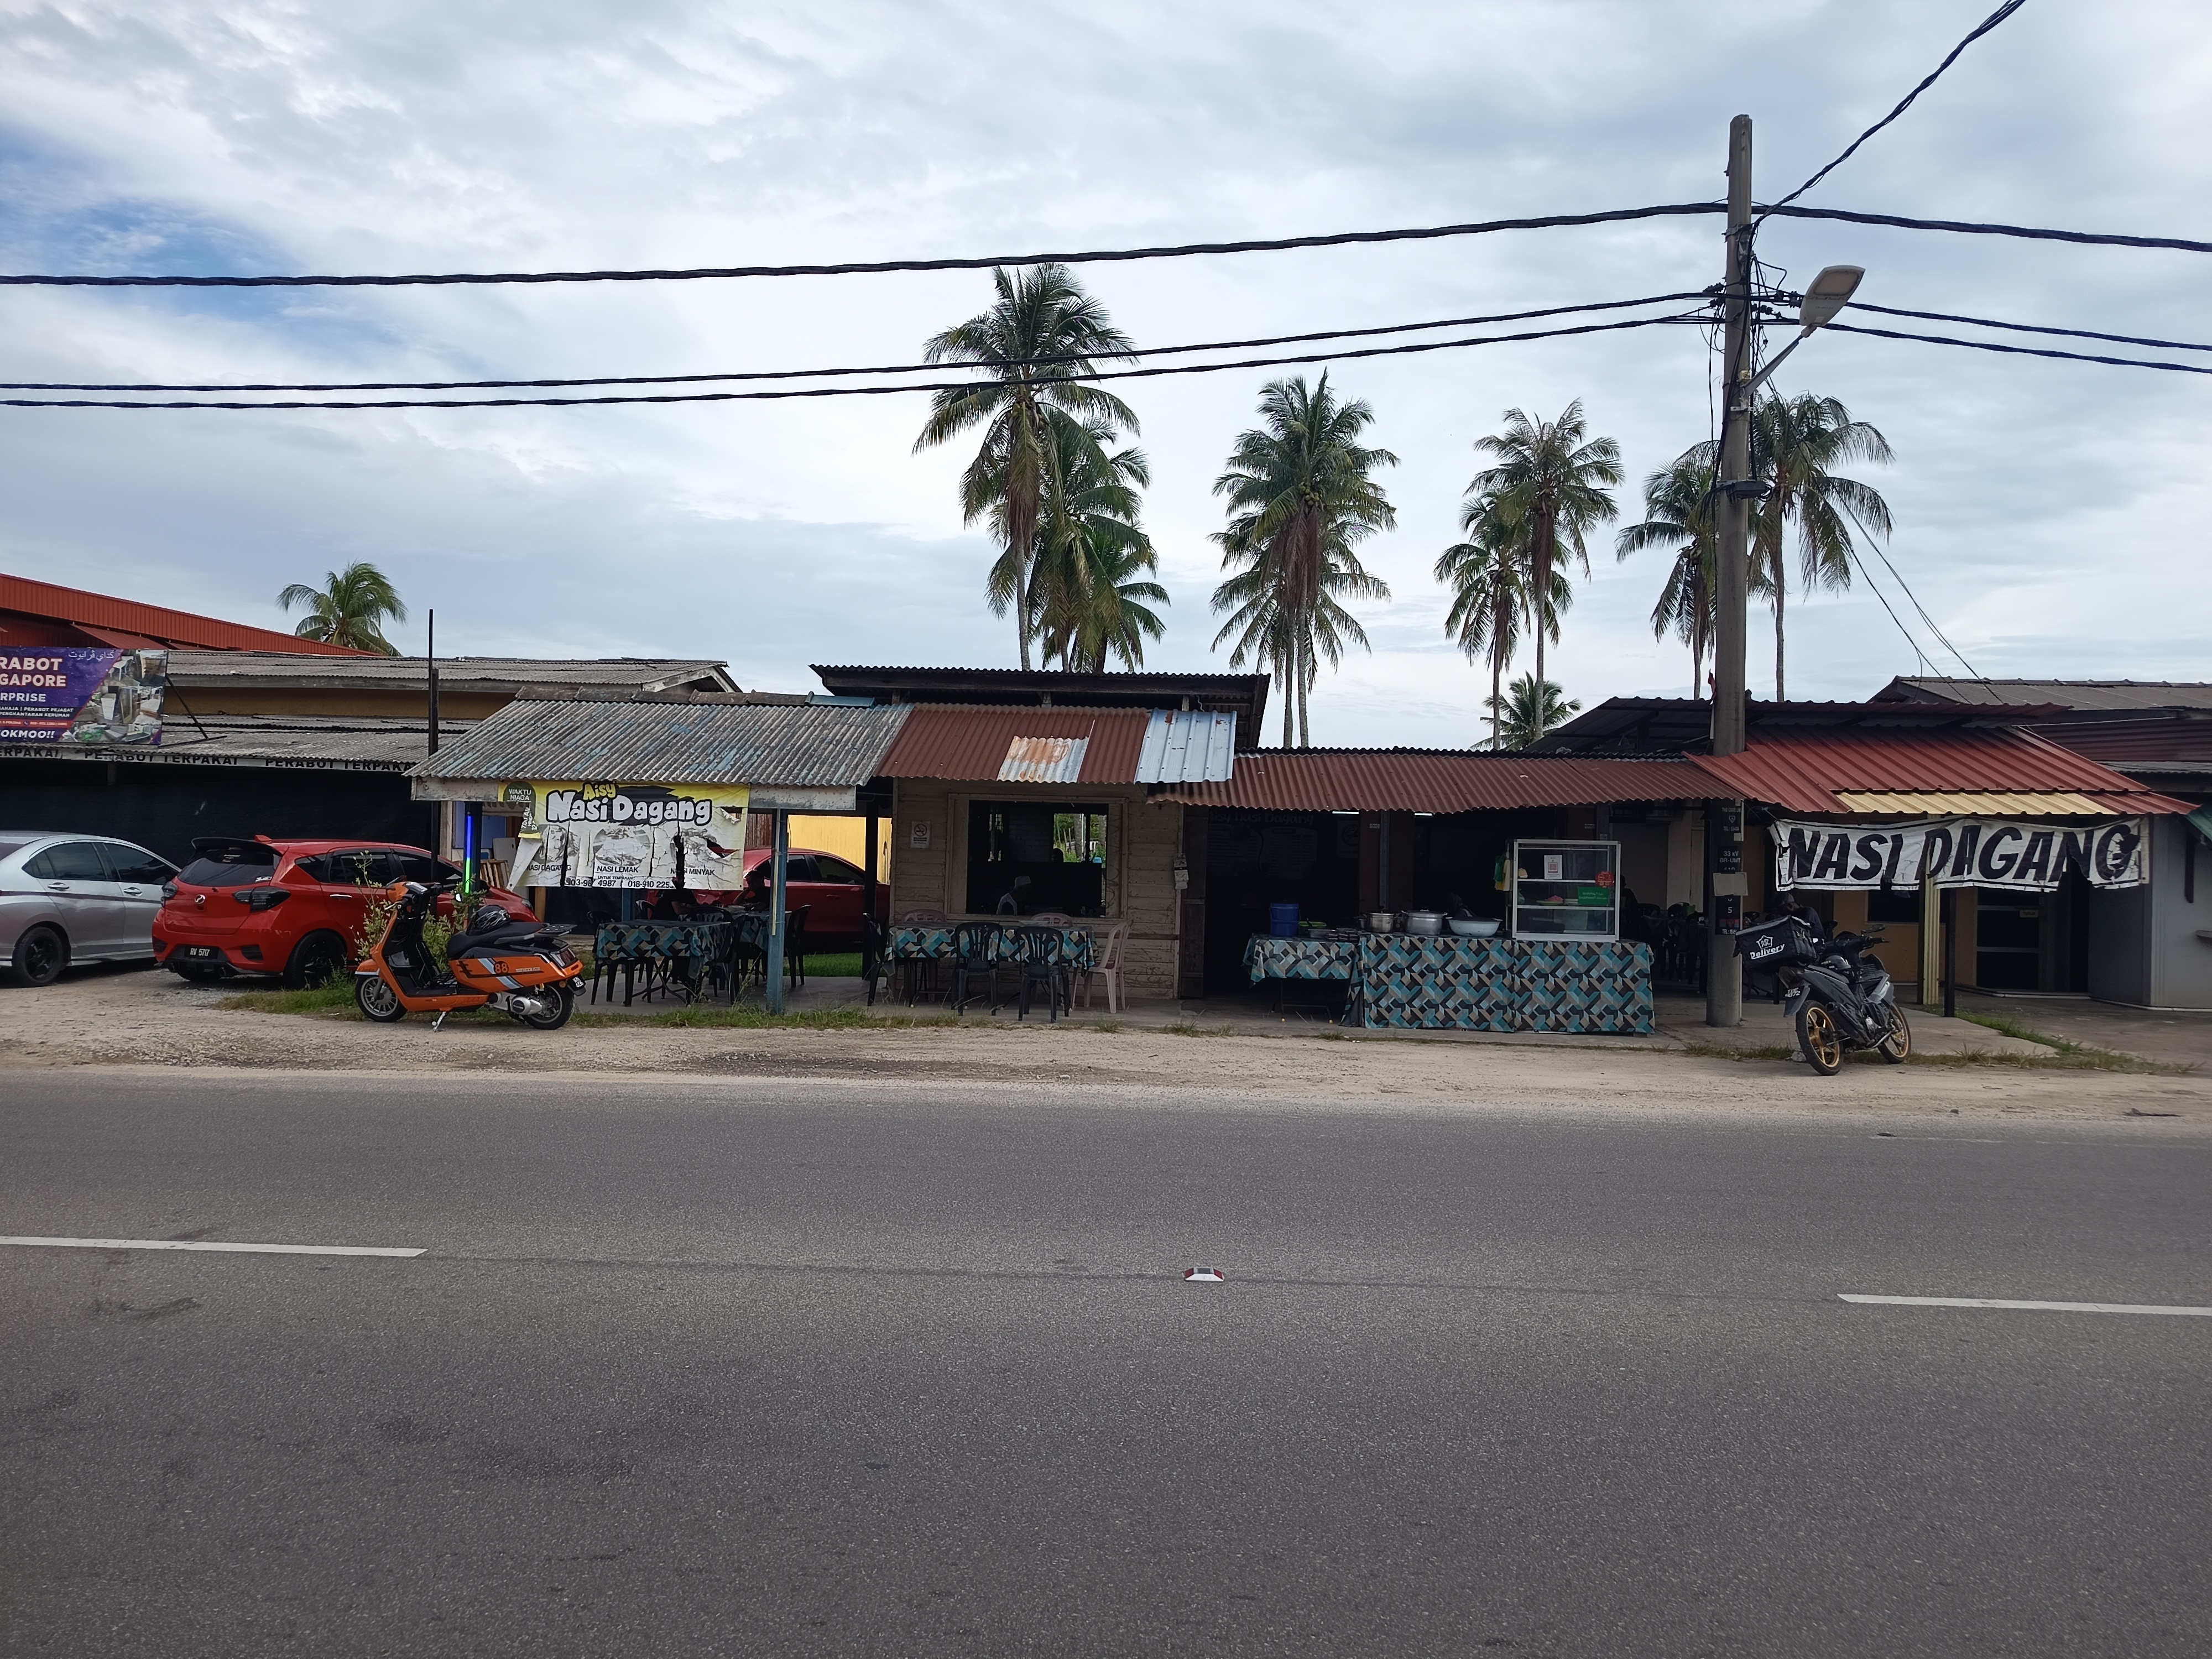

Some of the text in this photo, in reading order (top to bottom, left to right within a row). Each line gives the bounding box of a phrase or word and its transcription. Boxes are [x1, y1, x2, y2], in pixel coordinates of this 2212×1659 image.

[0, 673, 66, 687] GAPORE
[1, 692, 46, 702] RPRISE
[265, 759, 333, 768] PERABOT
[583, 782, 617, 800] Aisy
[547, 791, 712, 825] Nasi Dagang
[1788, 823, 2134, 882] NASI DAGANG
[1750, 943, 1785, 959] Delivery
[495, 963, 508, 974] 88
